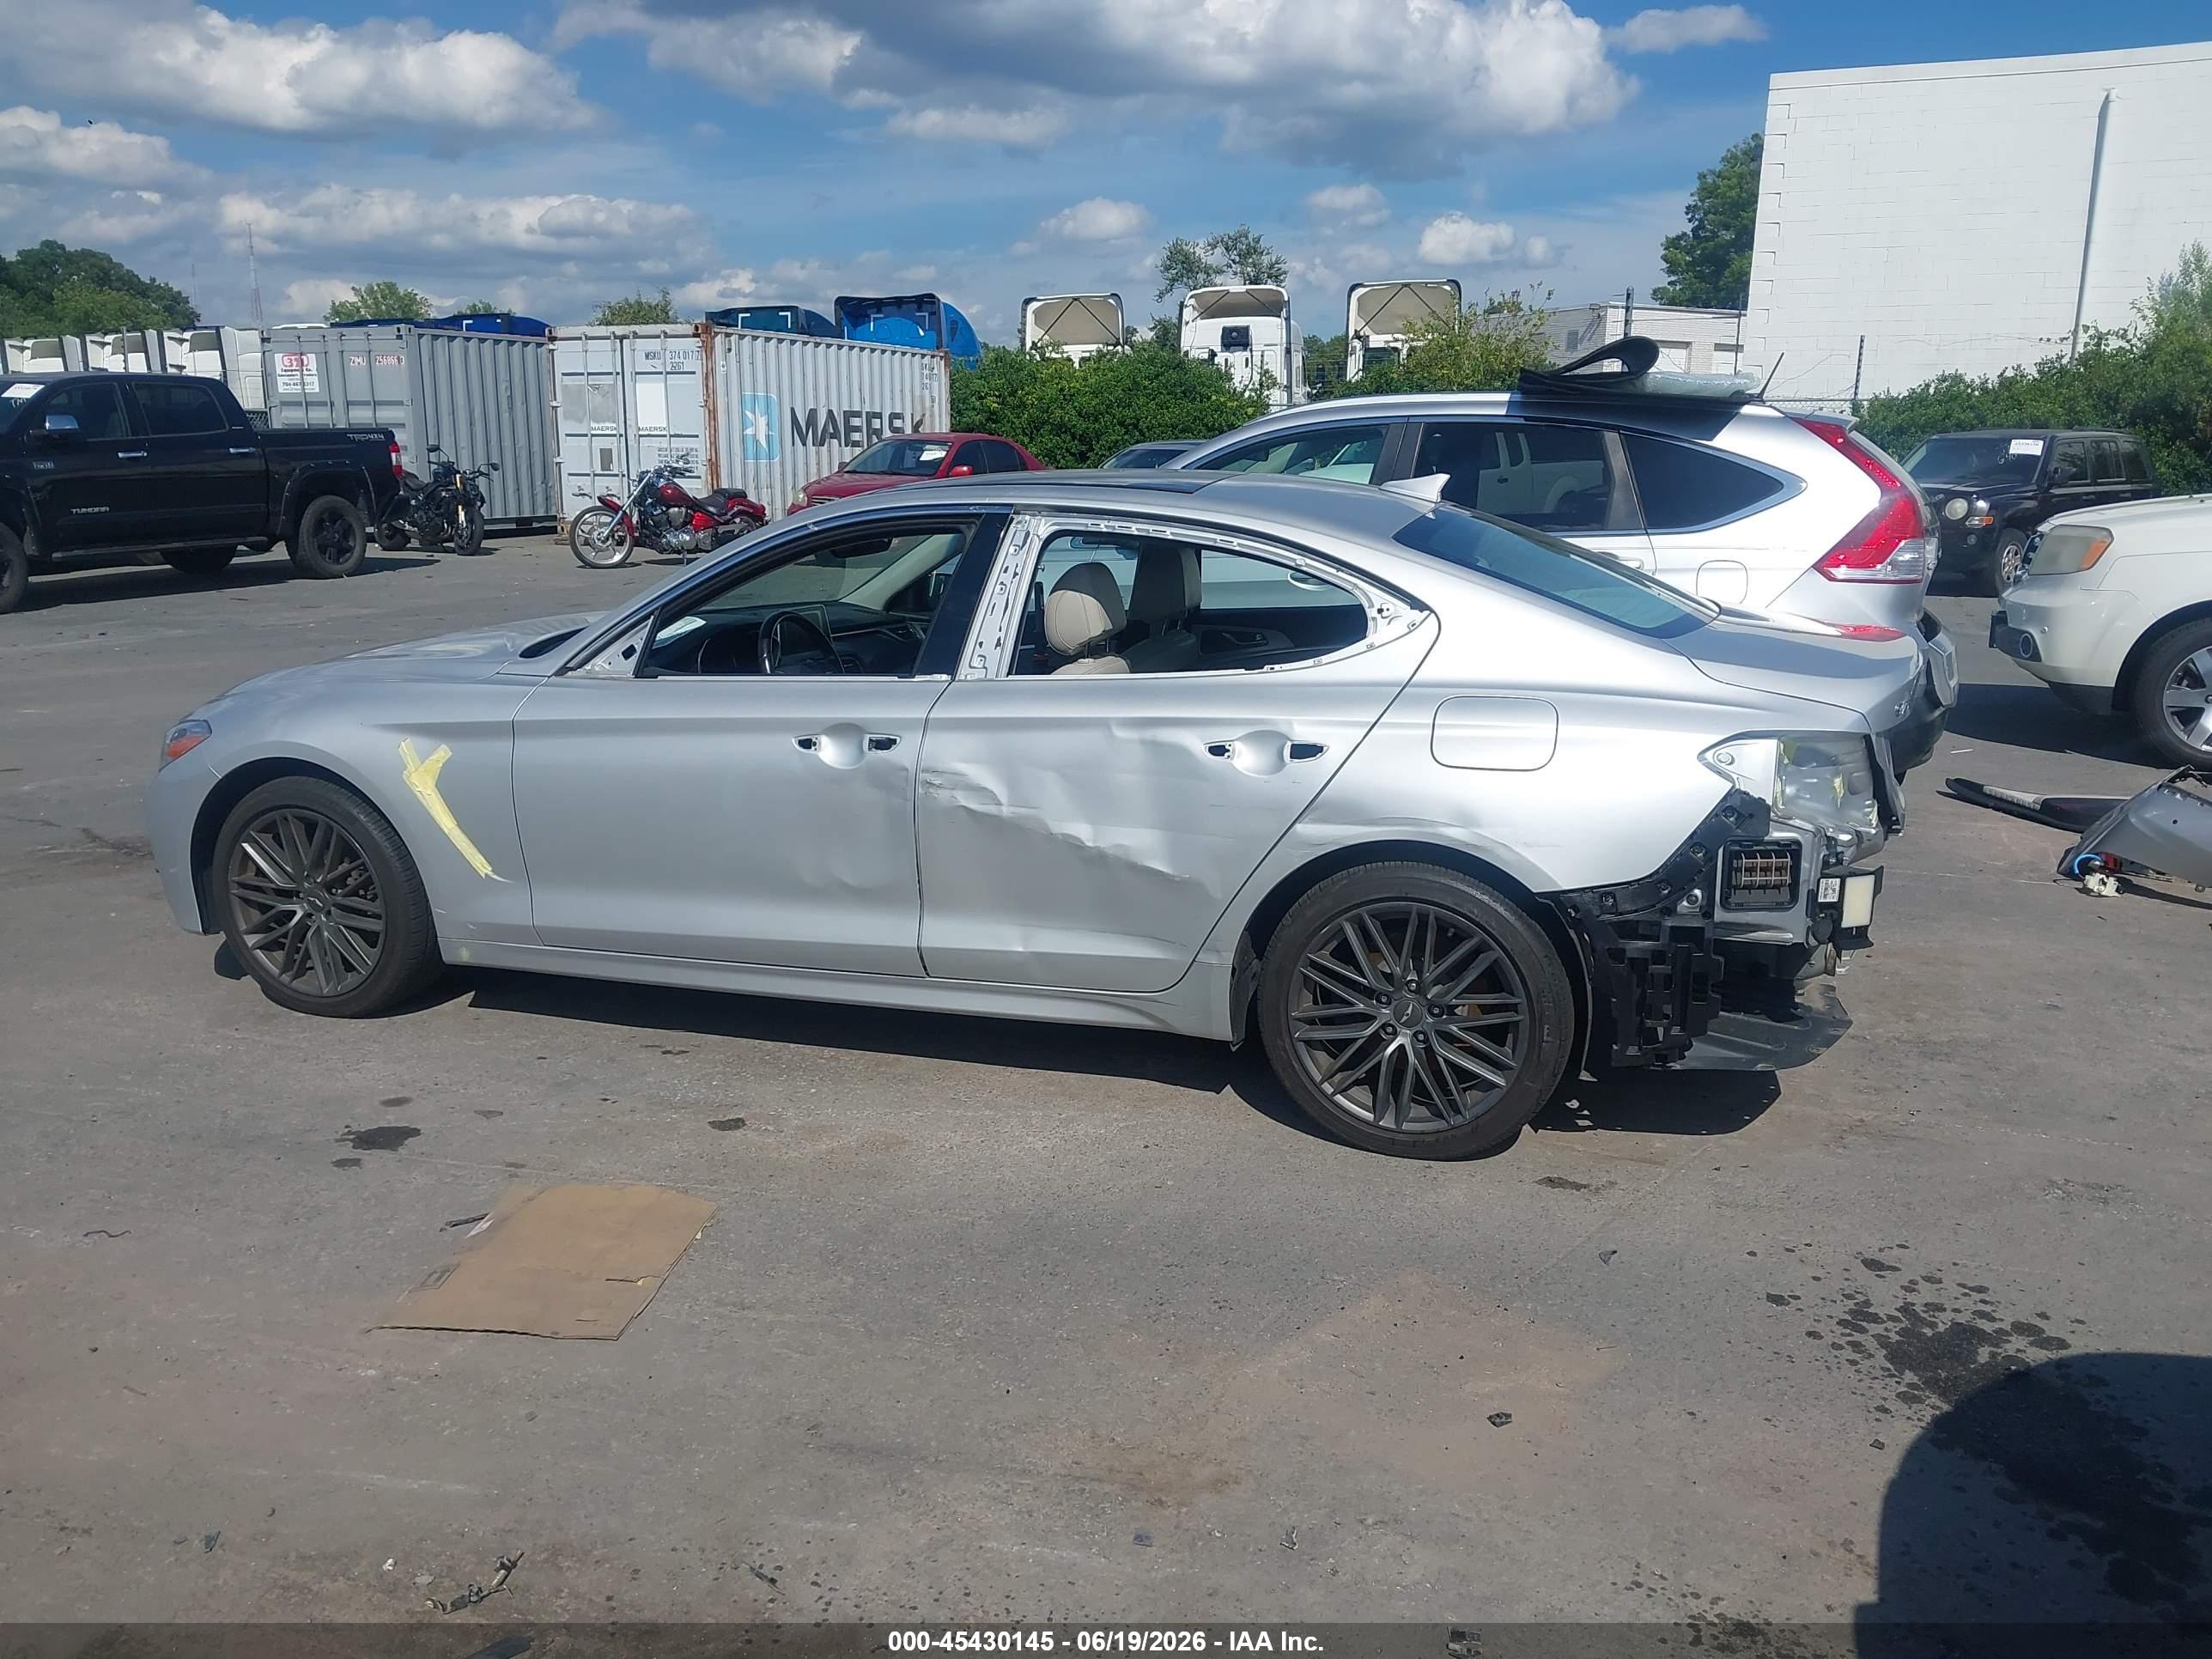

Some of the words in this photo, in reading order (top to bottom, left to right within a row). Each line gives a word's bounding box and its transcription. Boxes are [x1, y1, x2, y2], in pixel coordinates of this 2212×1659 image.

[644, 350, 661, 361] MSKU
[349, 356, 366, 366] ZIMU
[790, 407, 926, 447] MAERSK
[70, 506, 110, 514] TUNDRA
